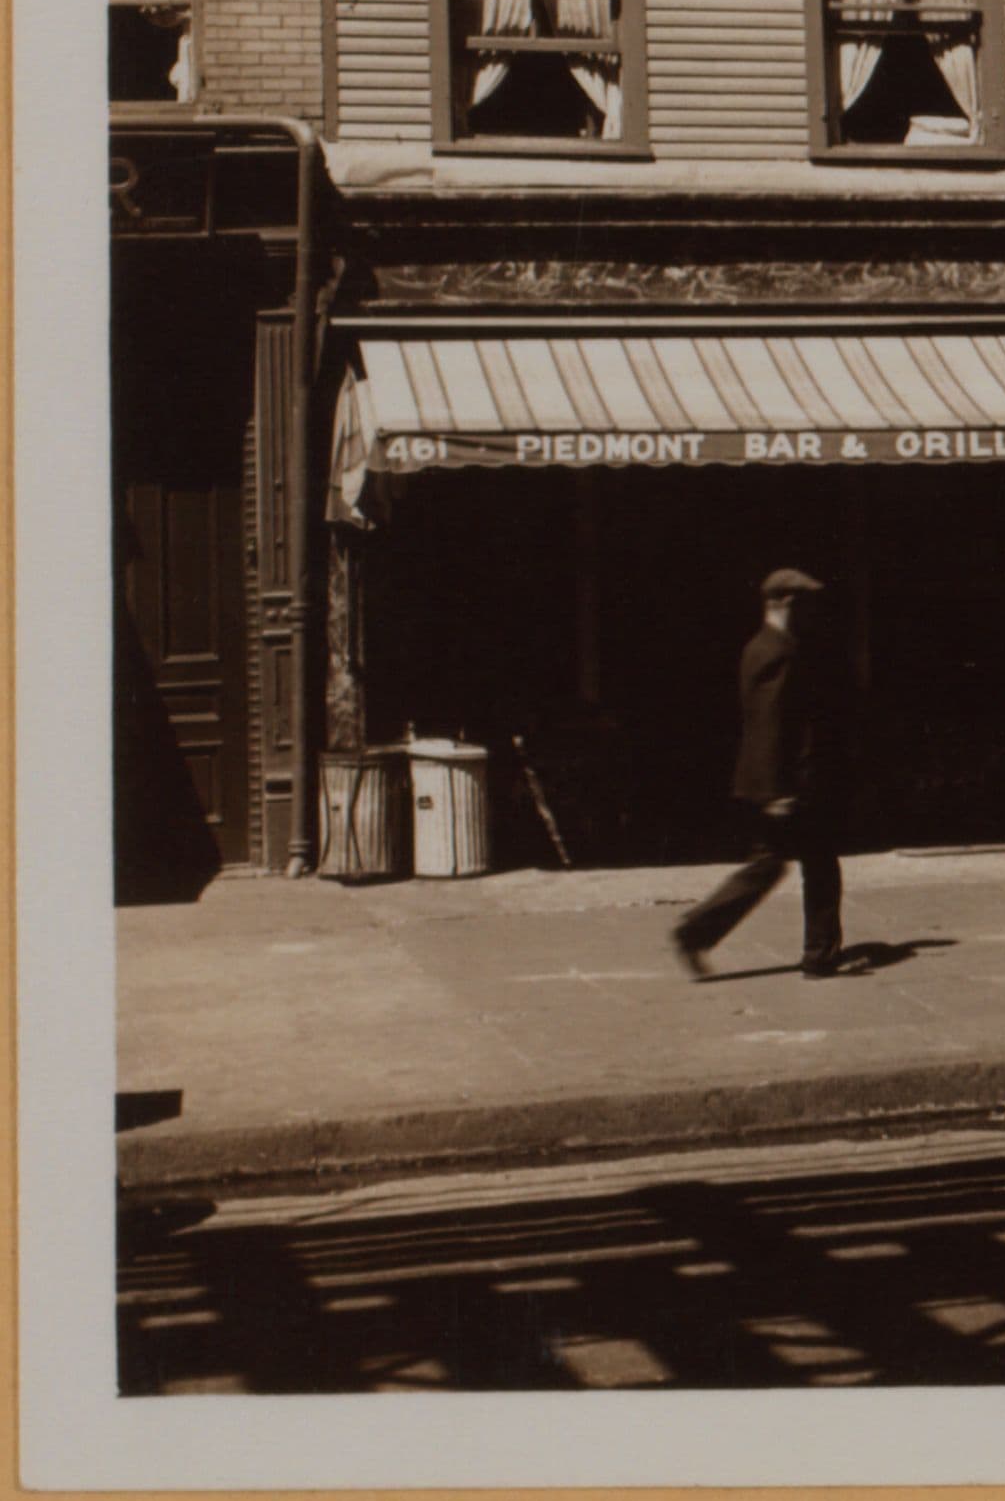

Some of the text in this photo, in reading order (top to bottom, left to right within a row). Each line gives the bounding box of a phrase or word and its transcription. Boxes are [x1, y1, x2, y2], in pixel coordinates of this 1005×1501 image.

[516, 432, 704, 463] PIEDMONT
[744, 431, 822, 460] BAR
[840, 433, 868, 459] &
